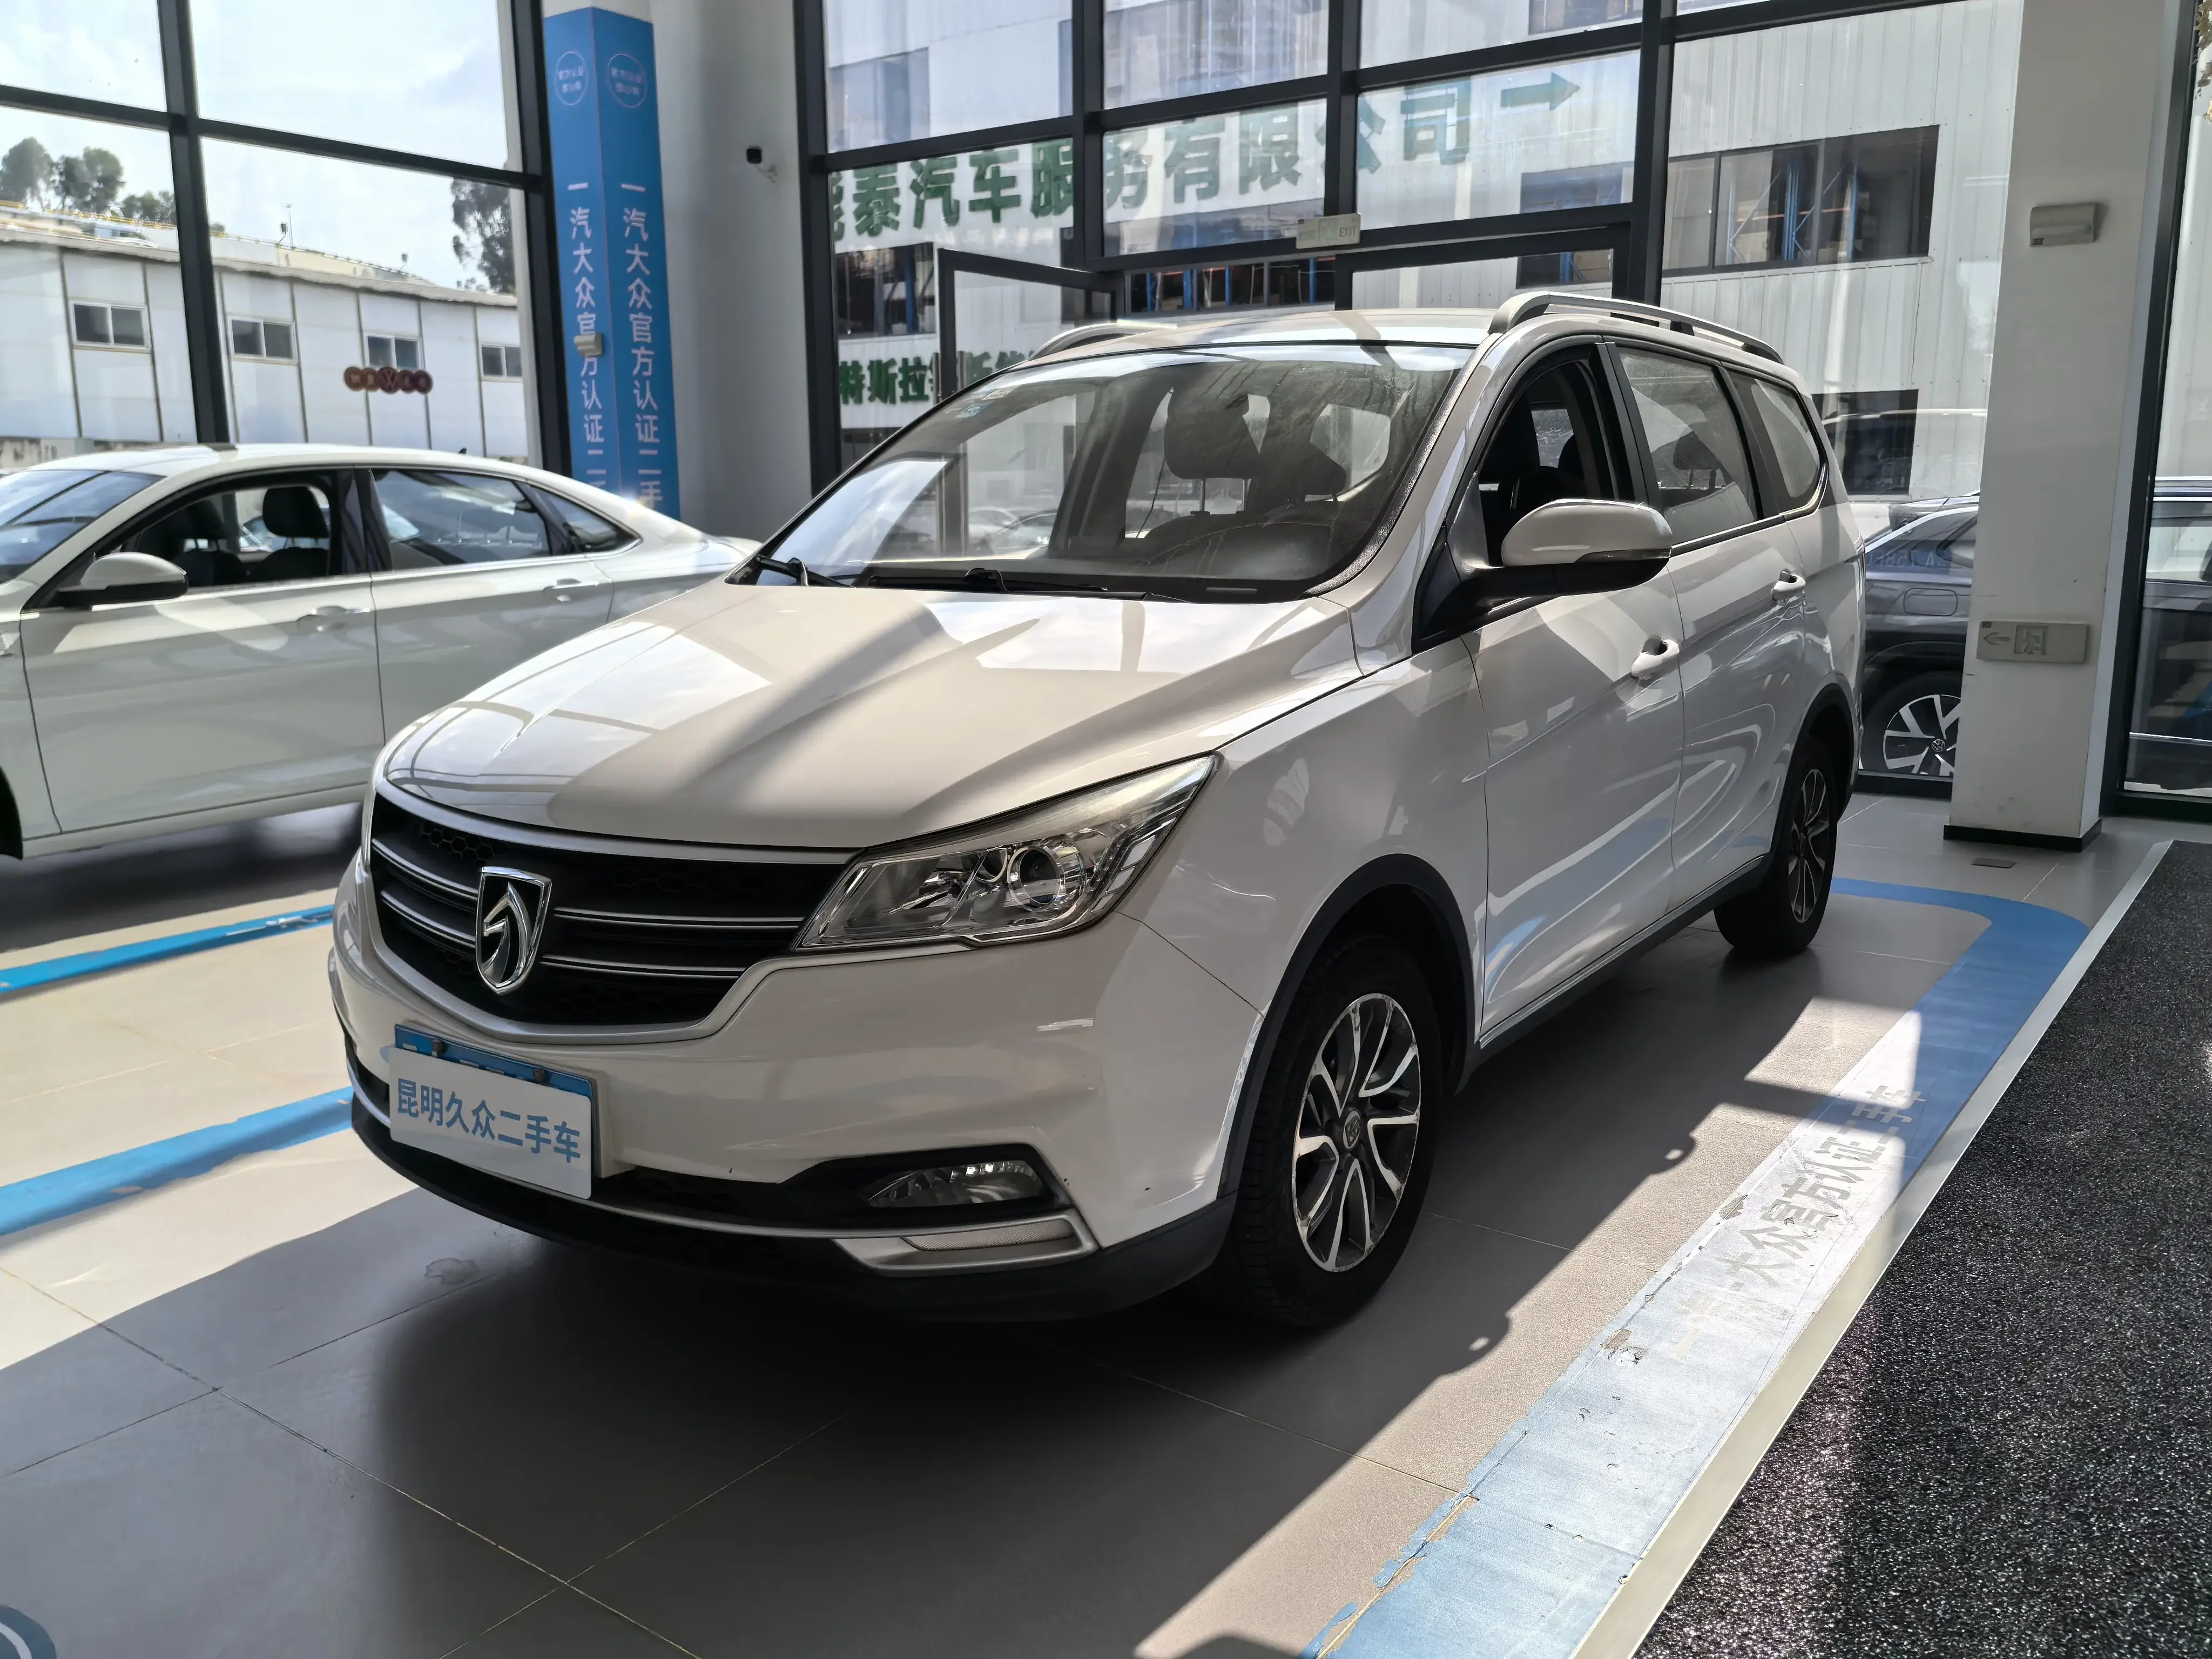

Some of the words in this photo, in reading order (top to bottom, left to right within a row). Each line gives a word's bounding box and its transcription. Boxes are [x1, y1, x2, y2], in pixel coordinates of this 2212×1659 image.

[1340, 226, 1356, 237] EXIT
[397, 1077, 581, 1164] 昆明久众二手车
